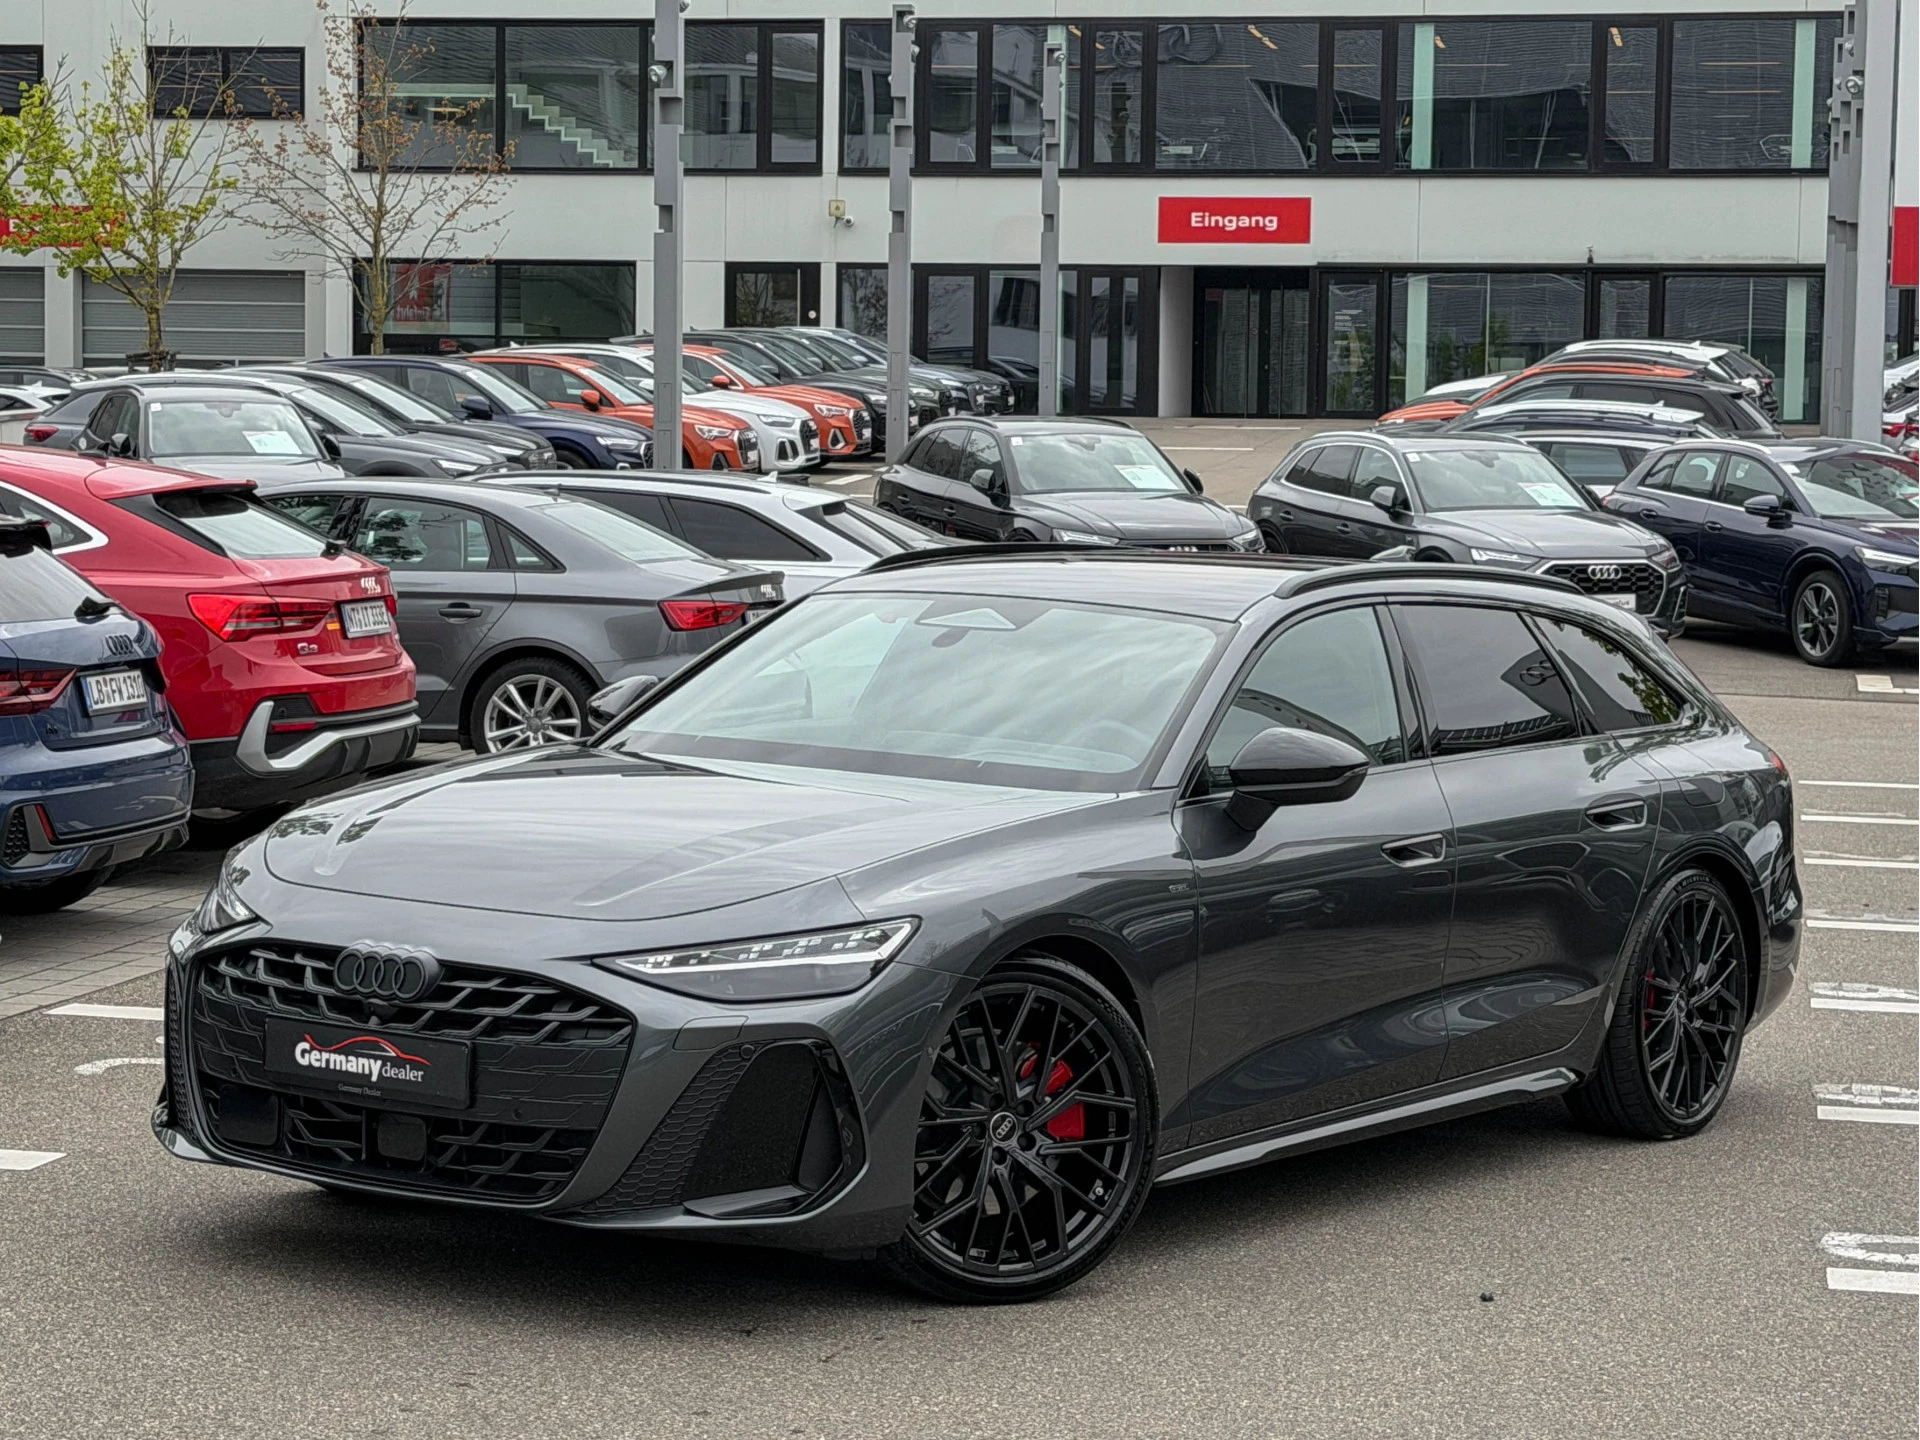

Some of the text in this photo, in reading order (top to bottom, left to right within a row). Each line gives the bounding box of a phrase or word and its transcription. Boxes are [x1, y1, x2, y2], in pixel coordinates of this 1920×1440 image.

[1190, 211, 1279, 231] Eingang
[88, 679, 106, 706] LB
[295, 1041, 424, 1082] Germany dealer
